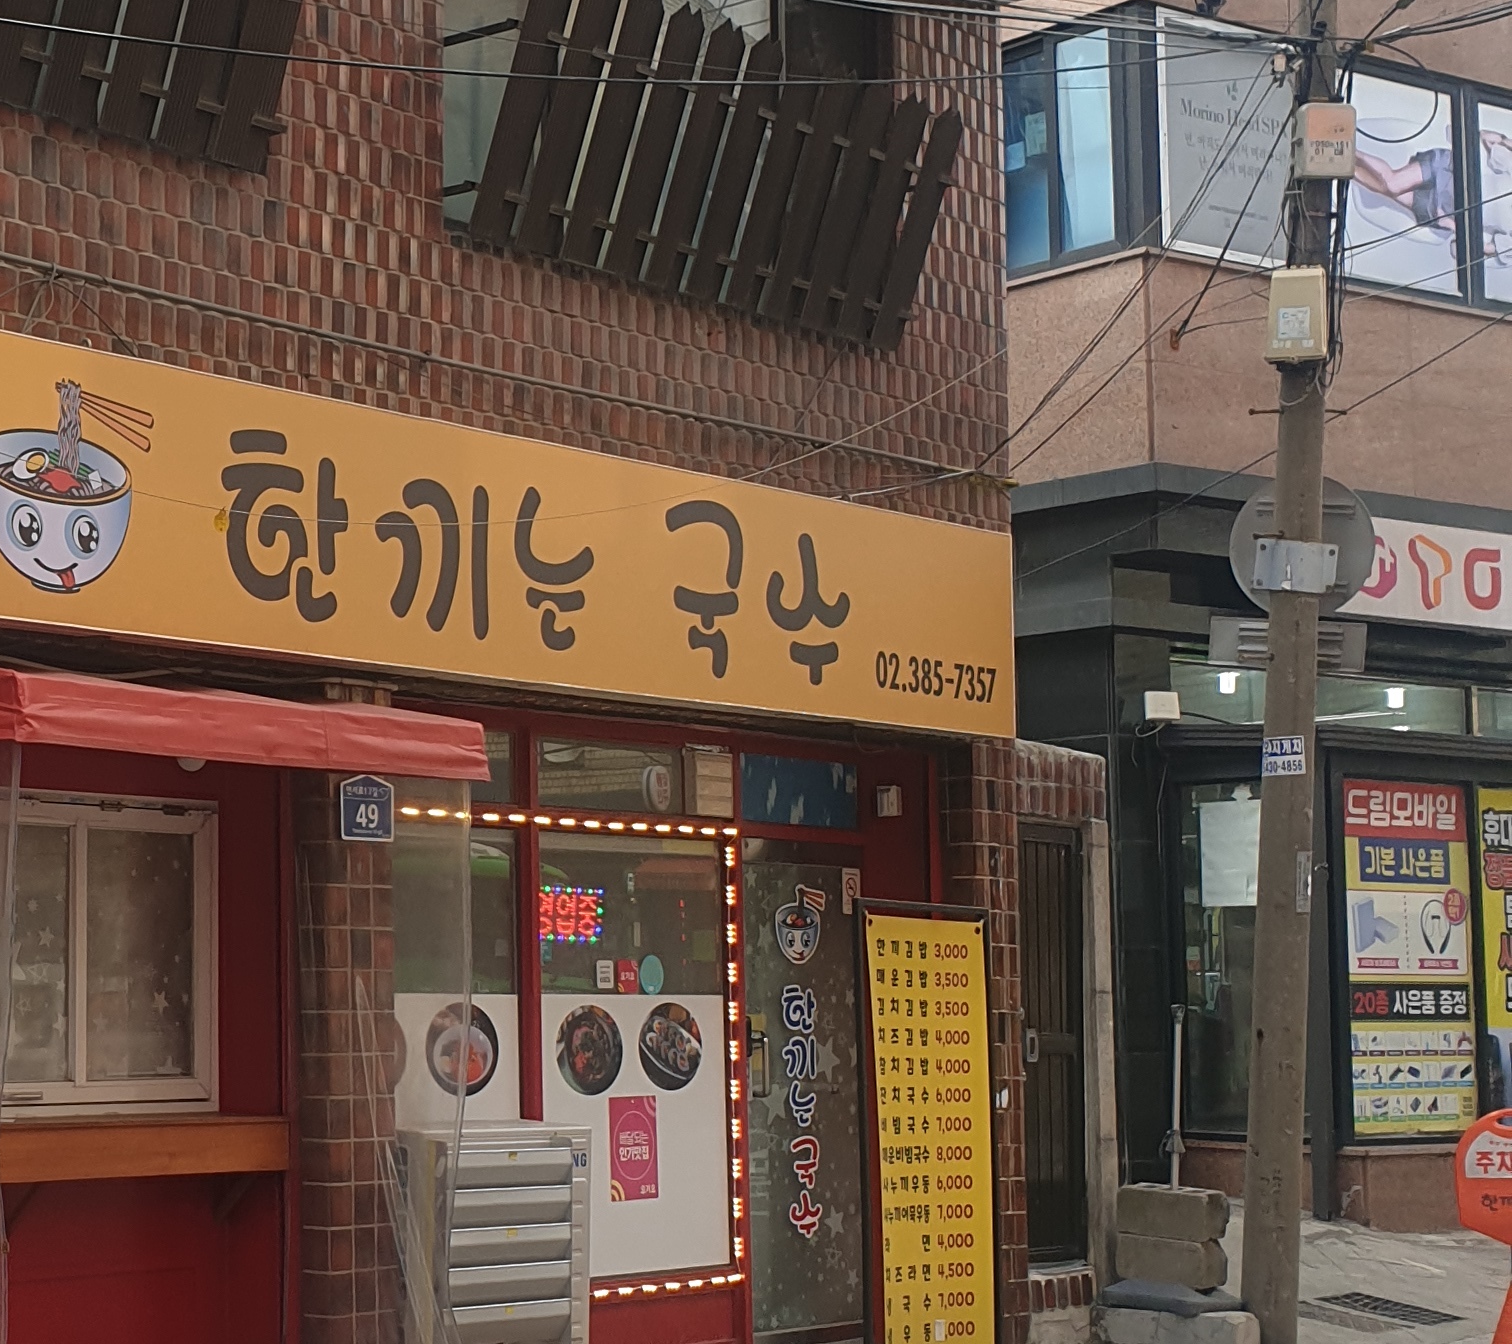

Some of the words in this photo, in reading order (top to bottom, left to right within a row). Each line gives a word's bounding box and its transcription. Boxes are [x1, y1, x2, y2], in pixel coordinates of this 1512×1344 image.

[1180, 97, 1225, 124] Morino
[221, 428, 595, 652] 한끼는
[664, 499, 851, 687] 국수
[875, 650, 997, 703] 02.385-7357
[355, 803, 379, 828] 49
[1346, 788, 1457, 831] 드림모바일
[1364, 846, 1396, 876] 기본
[1399, 847, 1445, 878] 사은품
[934, 943, 968, 960] 3,000
[934, 972, 969, 989] 3,500
[935, 1000, 969, 1018] 3,500
[1353, 990, 1389, 1015] 20종
[1393, 989, 1436, 1015] 사은품
[1440, 990, 1467, 1015] 증정
[935, 1029, 970, 1047] 4,000
[935, 1059, 971, 1076] 4,000
[936, 1087, 971, 1105] 6,000
[936, 1117, 972, 1134] 7,000
[936, 1145, 973, 1163] 8,000
[789, 1136, 822, 1238] 국수
[936, 1175, 973, 1193] 6,000
[937, 1204, 974, 1223] 7,000
[937, 1233, 974, 1251] 4,000
[938, 1262, 975, 1280] 4,500
[938, 1291, 975, 1310] 7,000
[938, 1321, 975, 1341] ,000
